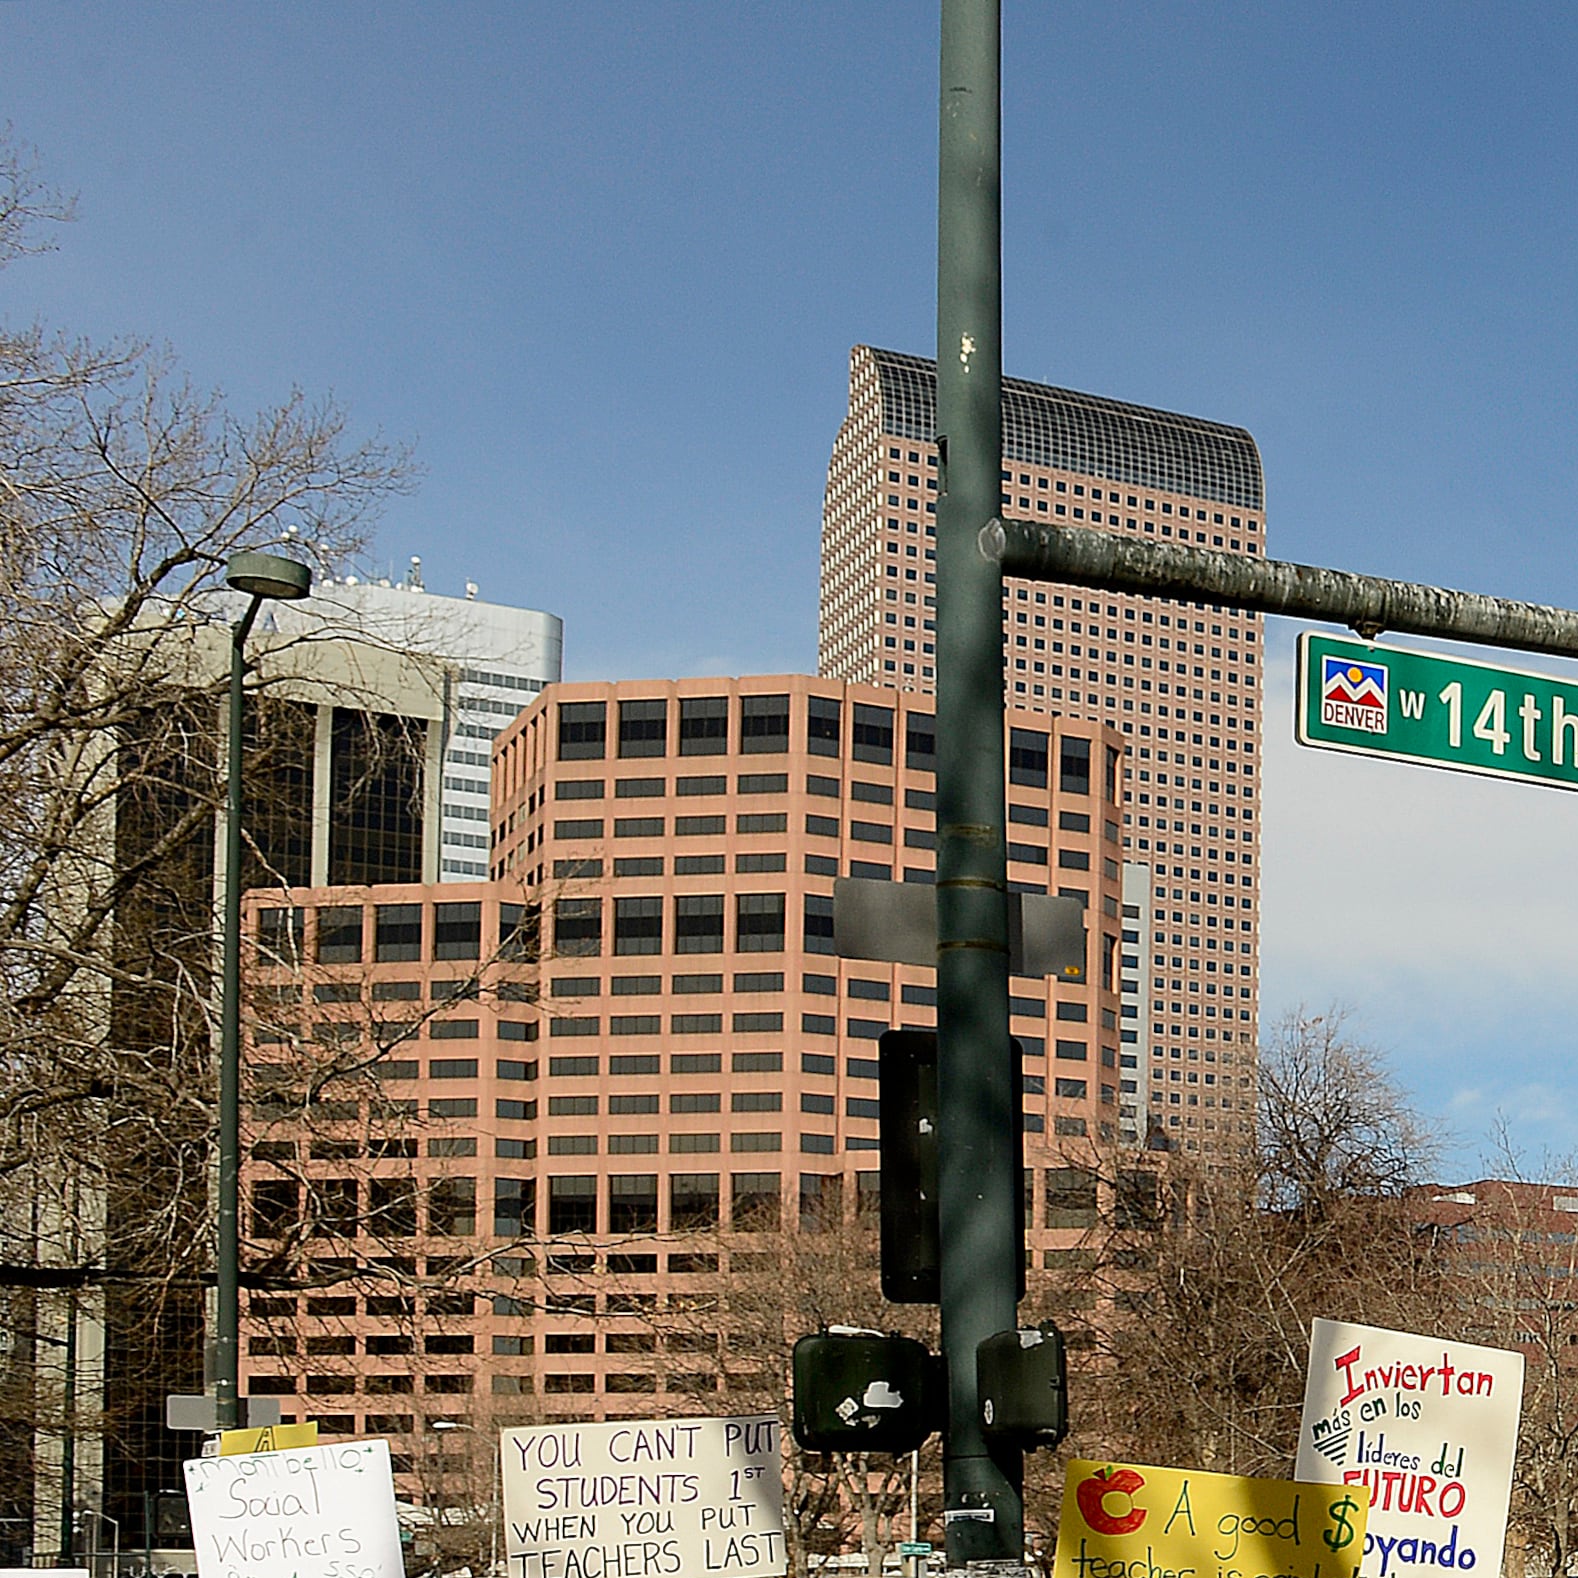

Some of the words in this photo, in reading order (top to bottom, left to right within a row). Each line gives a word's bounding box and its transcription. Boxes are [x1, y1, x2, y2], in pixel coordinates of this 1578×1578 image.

[1323, 702, 1386, 732] DENVER
[1399, 688, 1426, 720] W
[1334, 1345, 1494, 1408] Inviertan
[1313, 1408, 1351, 1440] más
[1360, 1396, 1387, 1422] en
[1396, 1392, 1421, 1420] los
[513, 1433, 582, 1471] YOU
[609, 1424, 702, 1462] CAN'T
[725, 1420, 779, 1457] PUT
[1357, 1431, 1421, 1471] líderes
[1431, 1443, 1464, 1479] del
[218, 1468, 321, 1519] Social
[536, 1475, 700, 1509] STUDENTS
[729, 1467, 766, 1500] 1ST
[512, 1515, 596, 1544] WHEN
[620, 1510, 674, 1535] YOU
[701, 1505, 757, 1530] PUT
[1164, 1480, 1196, 1536] A
[1213, 1495, 1301, 1560] good
[1323, 1494, 1360, 1552] $
[704, 1532, 782, 1570] LAST
